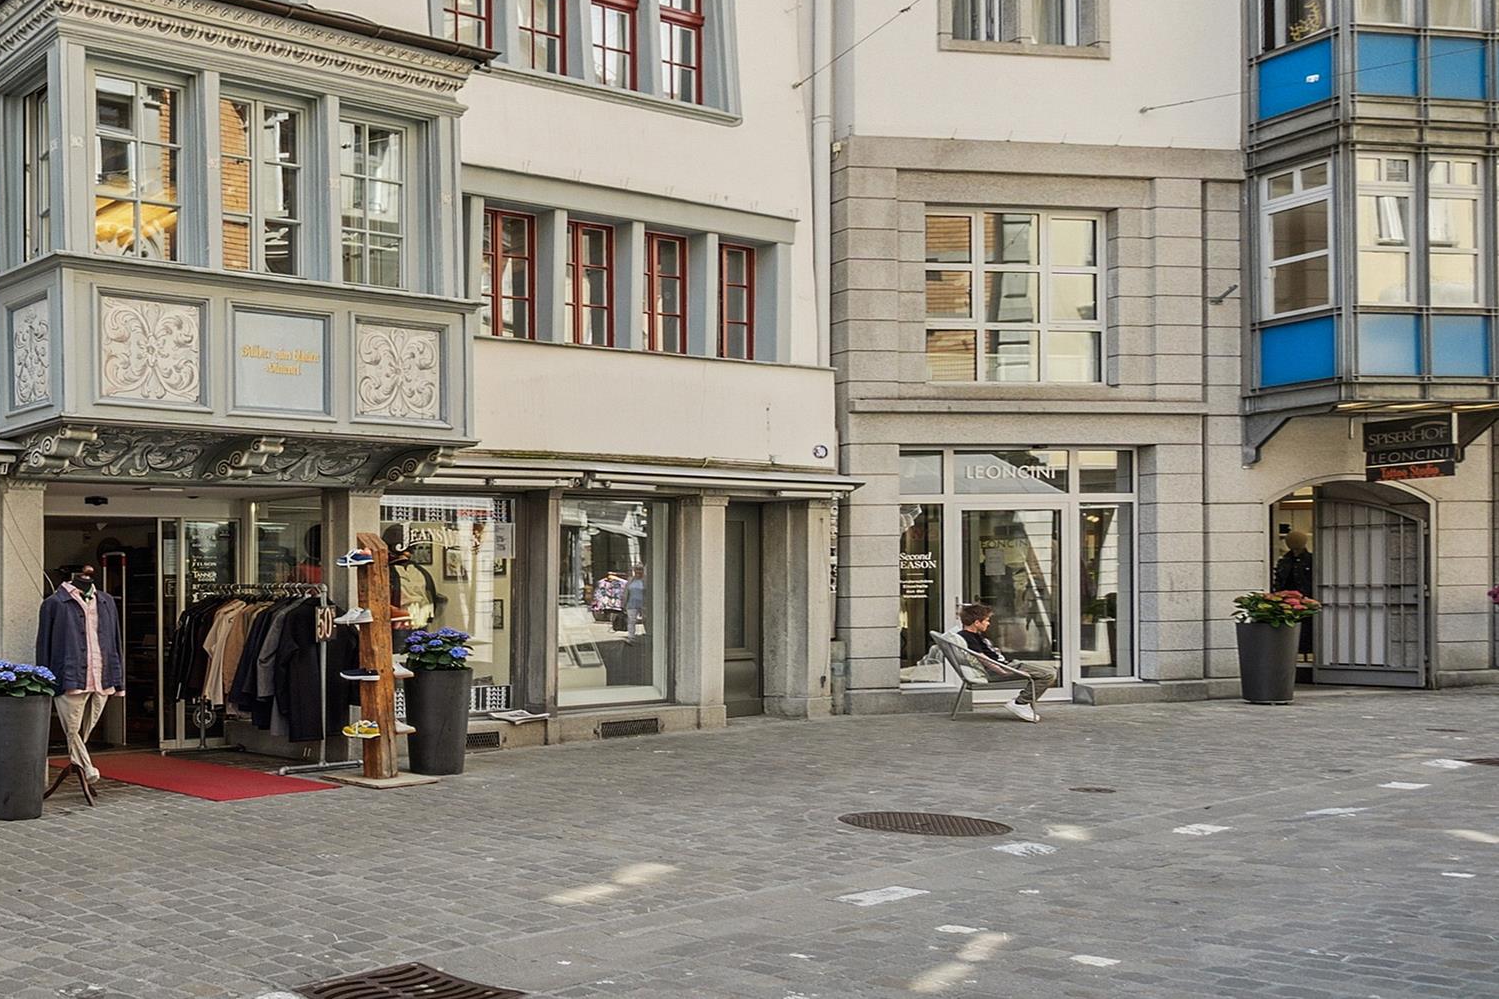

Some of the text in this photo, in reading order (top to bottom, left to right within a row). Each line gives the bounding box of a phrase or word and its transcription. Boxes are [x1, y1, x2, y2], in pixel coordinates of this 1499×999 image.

[1368, 427, 1448, 446] SPISERHOF
[1371, 447, 1449, 465] LEONCINI
[966, 465, 1056, 479] LEONCINI
[900, 552, 932, 561] Second
[900, 560, 937, 569] EASON
